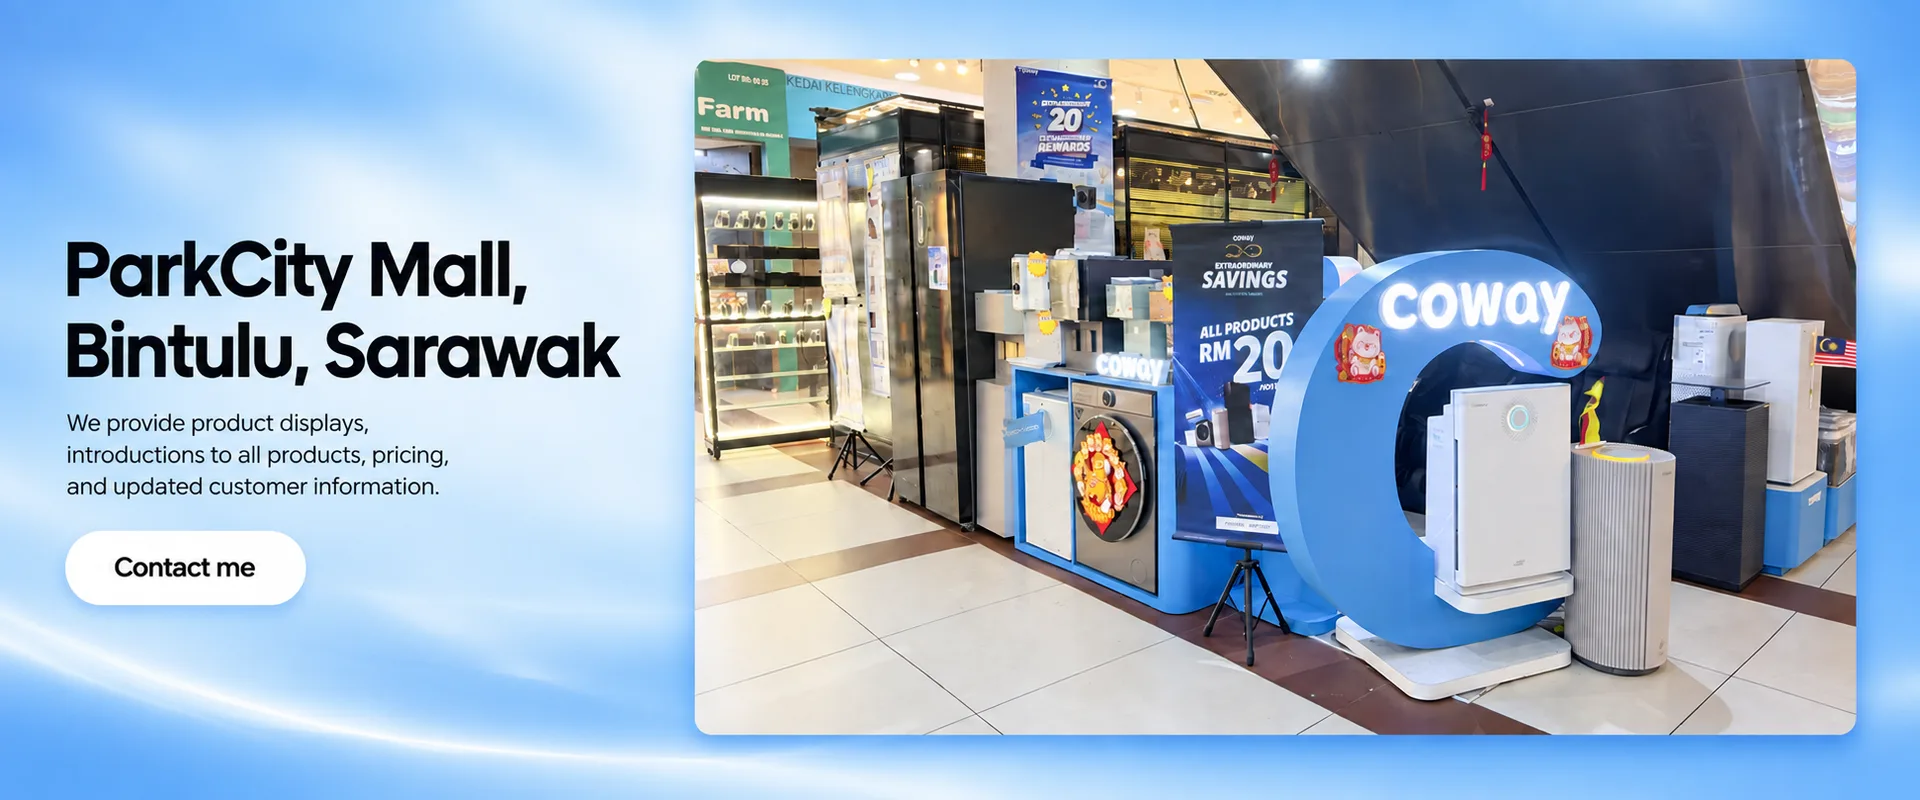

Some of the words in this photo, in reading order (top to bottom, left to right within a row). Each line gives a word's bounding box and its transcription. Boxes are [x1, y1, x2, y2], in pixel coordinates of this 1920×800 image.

[786, 75, 822, 91] KEDAI
[825, 83, 893, 100] KELENGKAP
[697, 96, 769, 123] Farm
[1047, 107, 1083, 132] 20
[1038, 141, 1091, 153] REWARDS
[1202, 269, 1289, 289] SAVINGS
[1378, 279, 1571, 336] coway
[1200, 324, 1223, 339] ALL
[1225, 311, 1294, 335] PRODUCTS
[1096, 353, 1164, 387] coway
